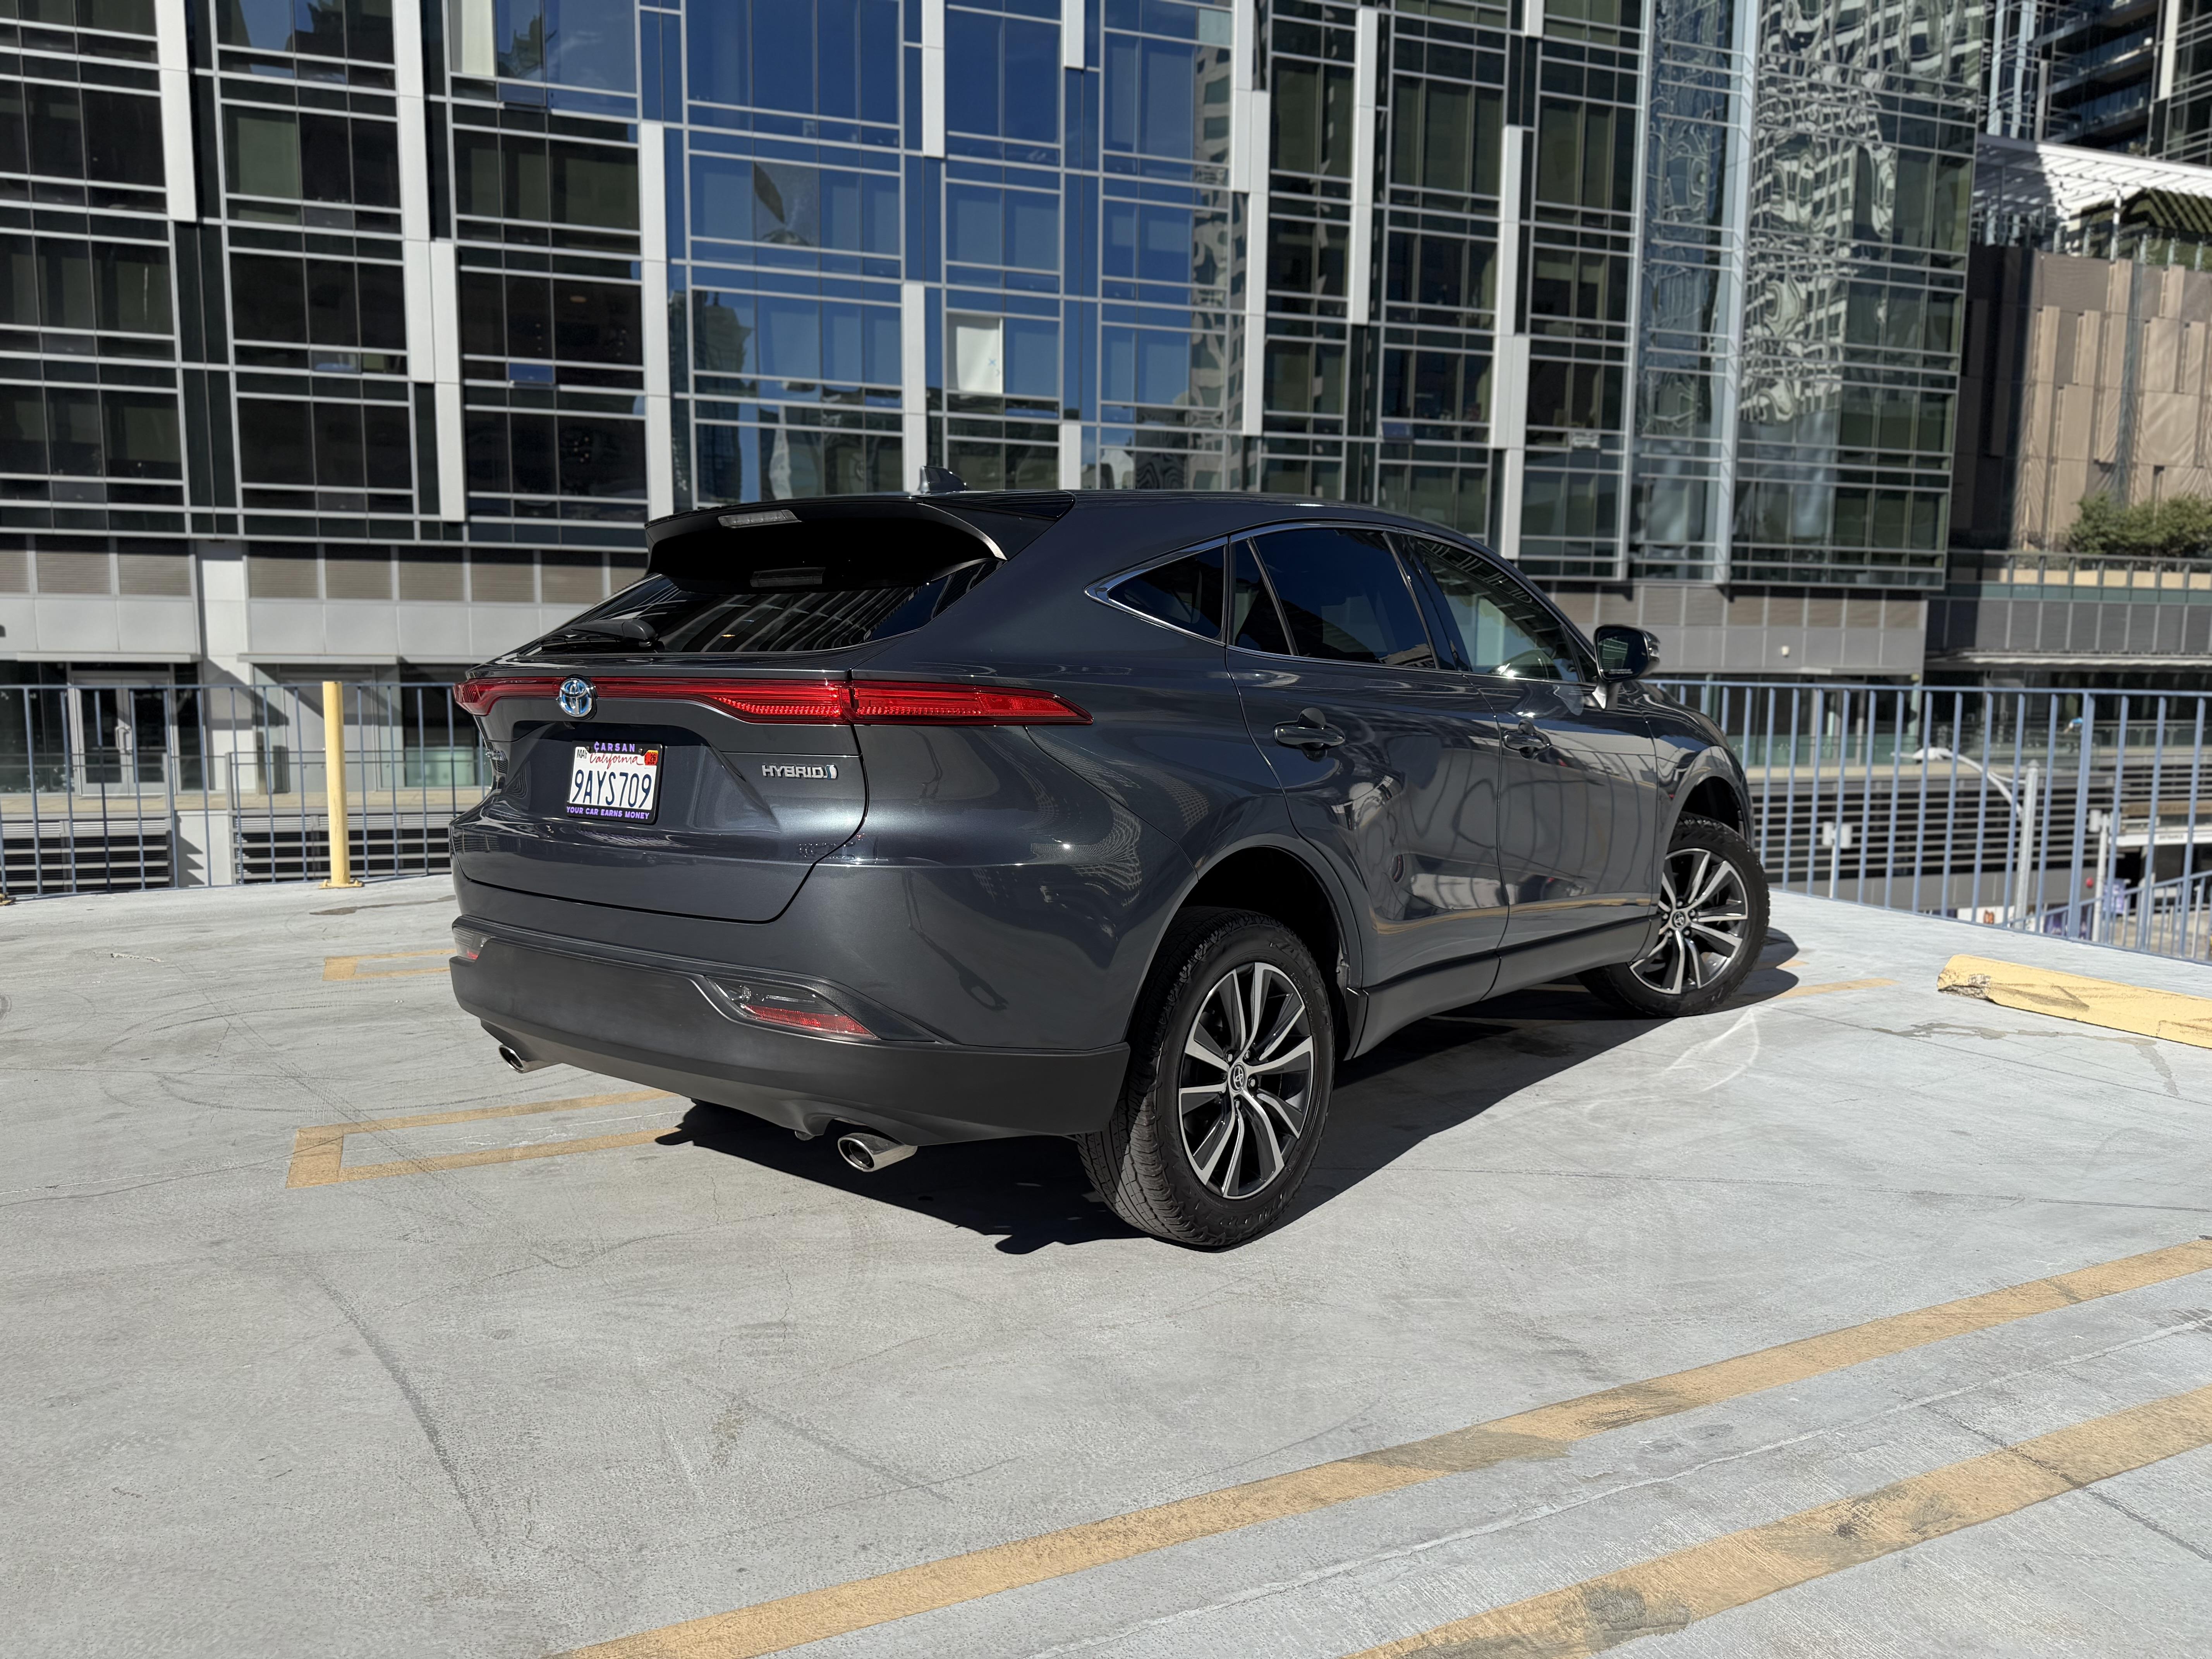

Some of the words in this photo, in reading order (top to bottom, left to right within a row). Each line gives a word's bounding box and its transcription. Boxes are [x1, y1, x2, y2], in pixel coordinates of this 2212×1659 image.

[577, 749, 587, 759] MAY
[589, 753, 644, 769] California
[762, 765, 824, 778] HYBRID
[572, 769, 652, 808] 9AYS709
[567, 806, 583, 814] YOUR
[625, 811, 649, 819] MONEY
